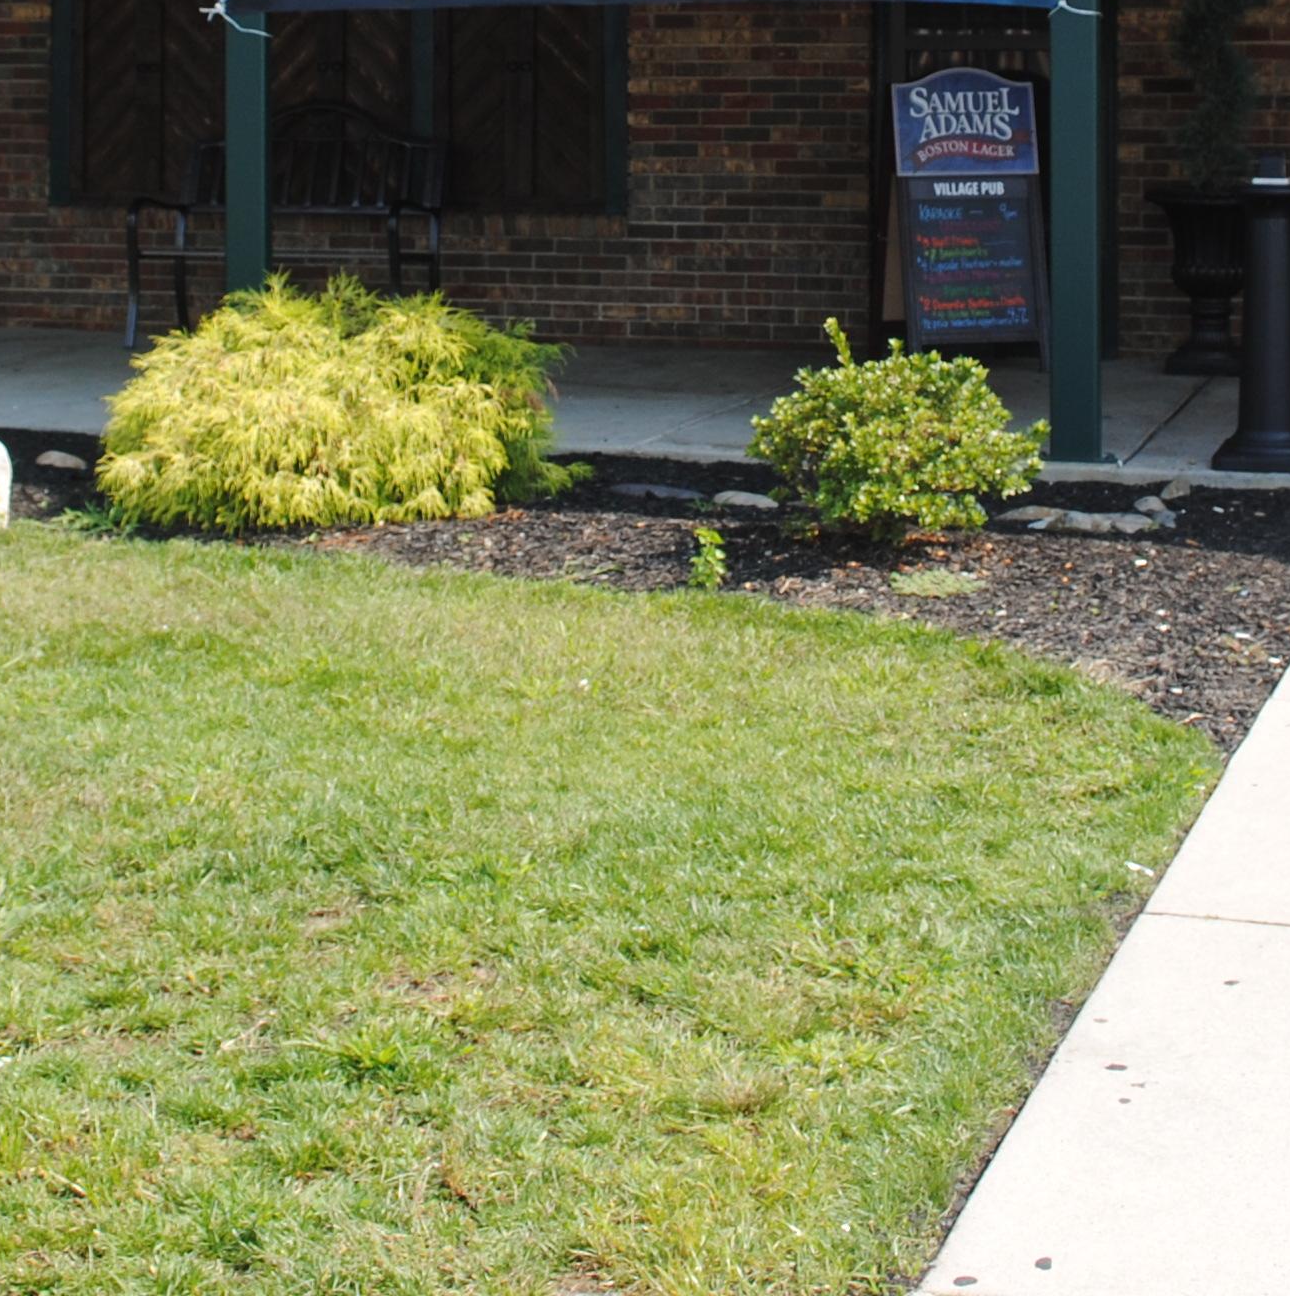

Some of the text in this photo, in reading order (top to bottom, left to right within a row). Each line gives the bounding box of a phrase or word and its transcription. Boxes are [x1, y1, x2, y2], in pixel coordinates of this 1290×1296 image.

[909, 86, 1020, 118] SAMUEL
[919, 112, 1013, 144] ADAMS
[917, 140, 1015, 163] BOSTON LAGER
[933, 181, 1005, 197] VILLAGE PUB
